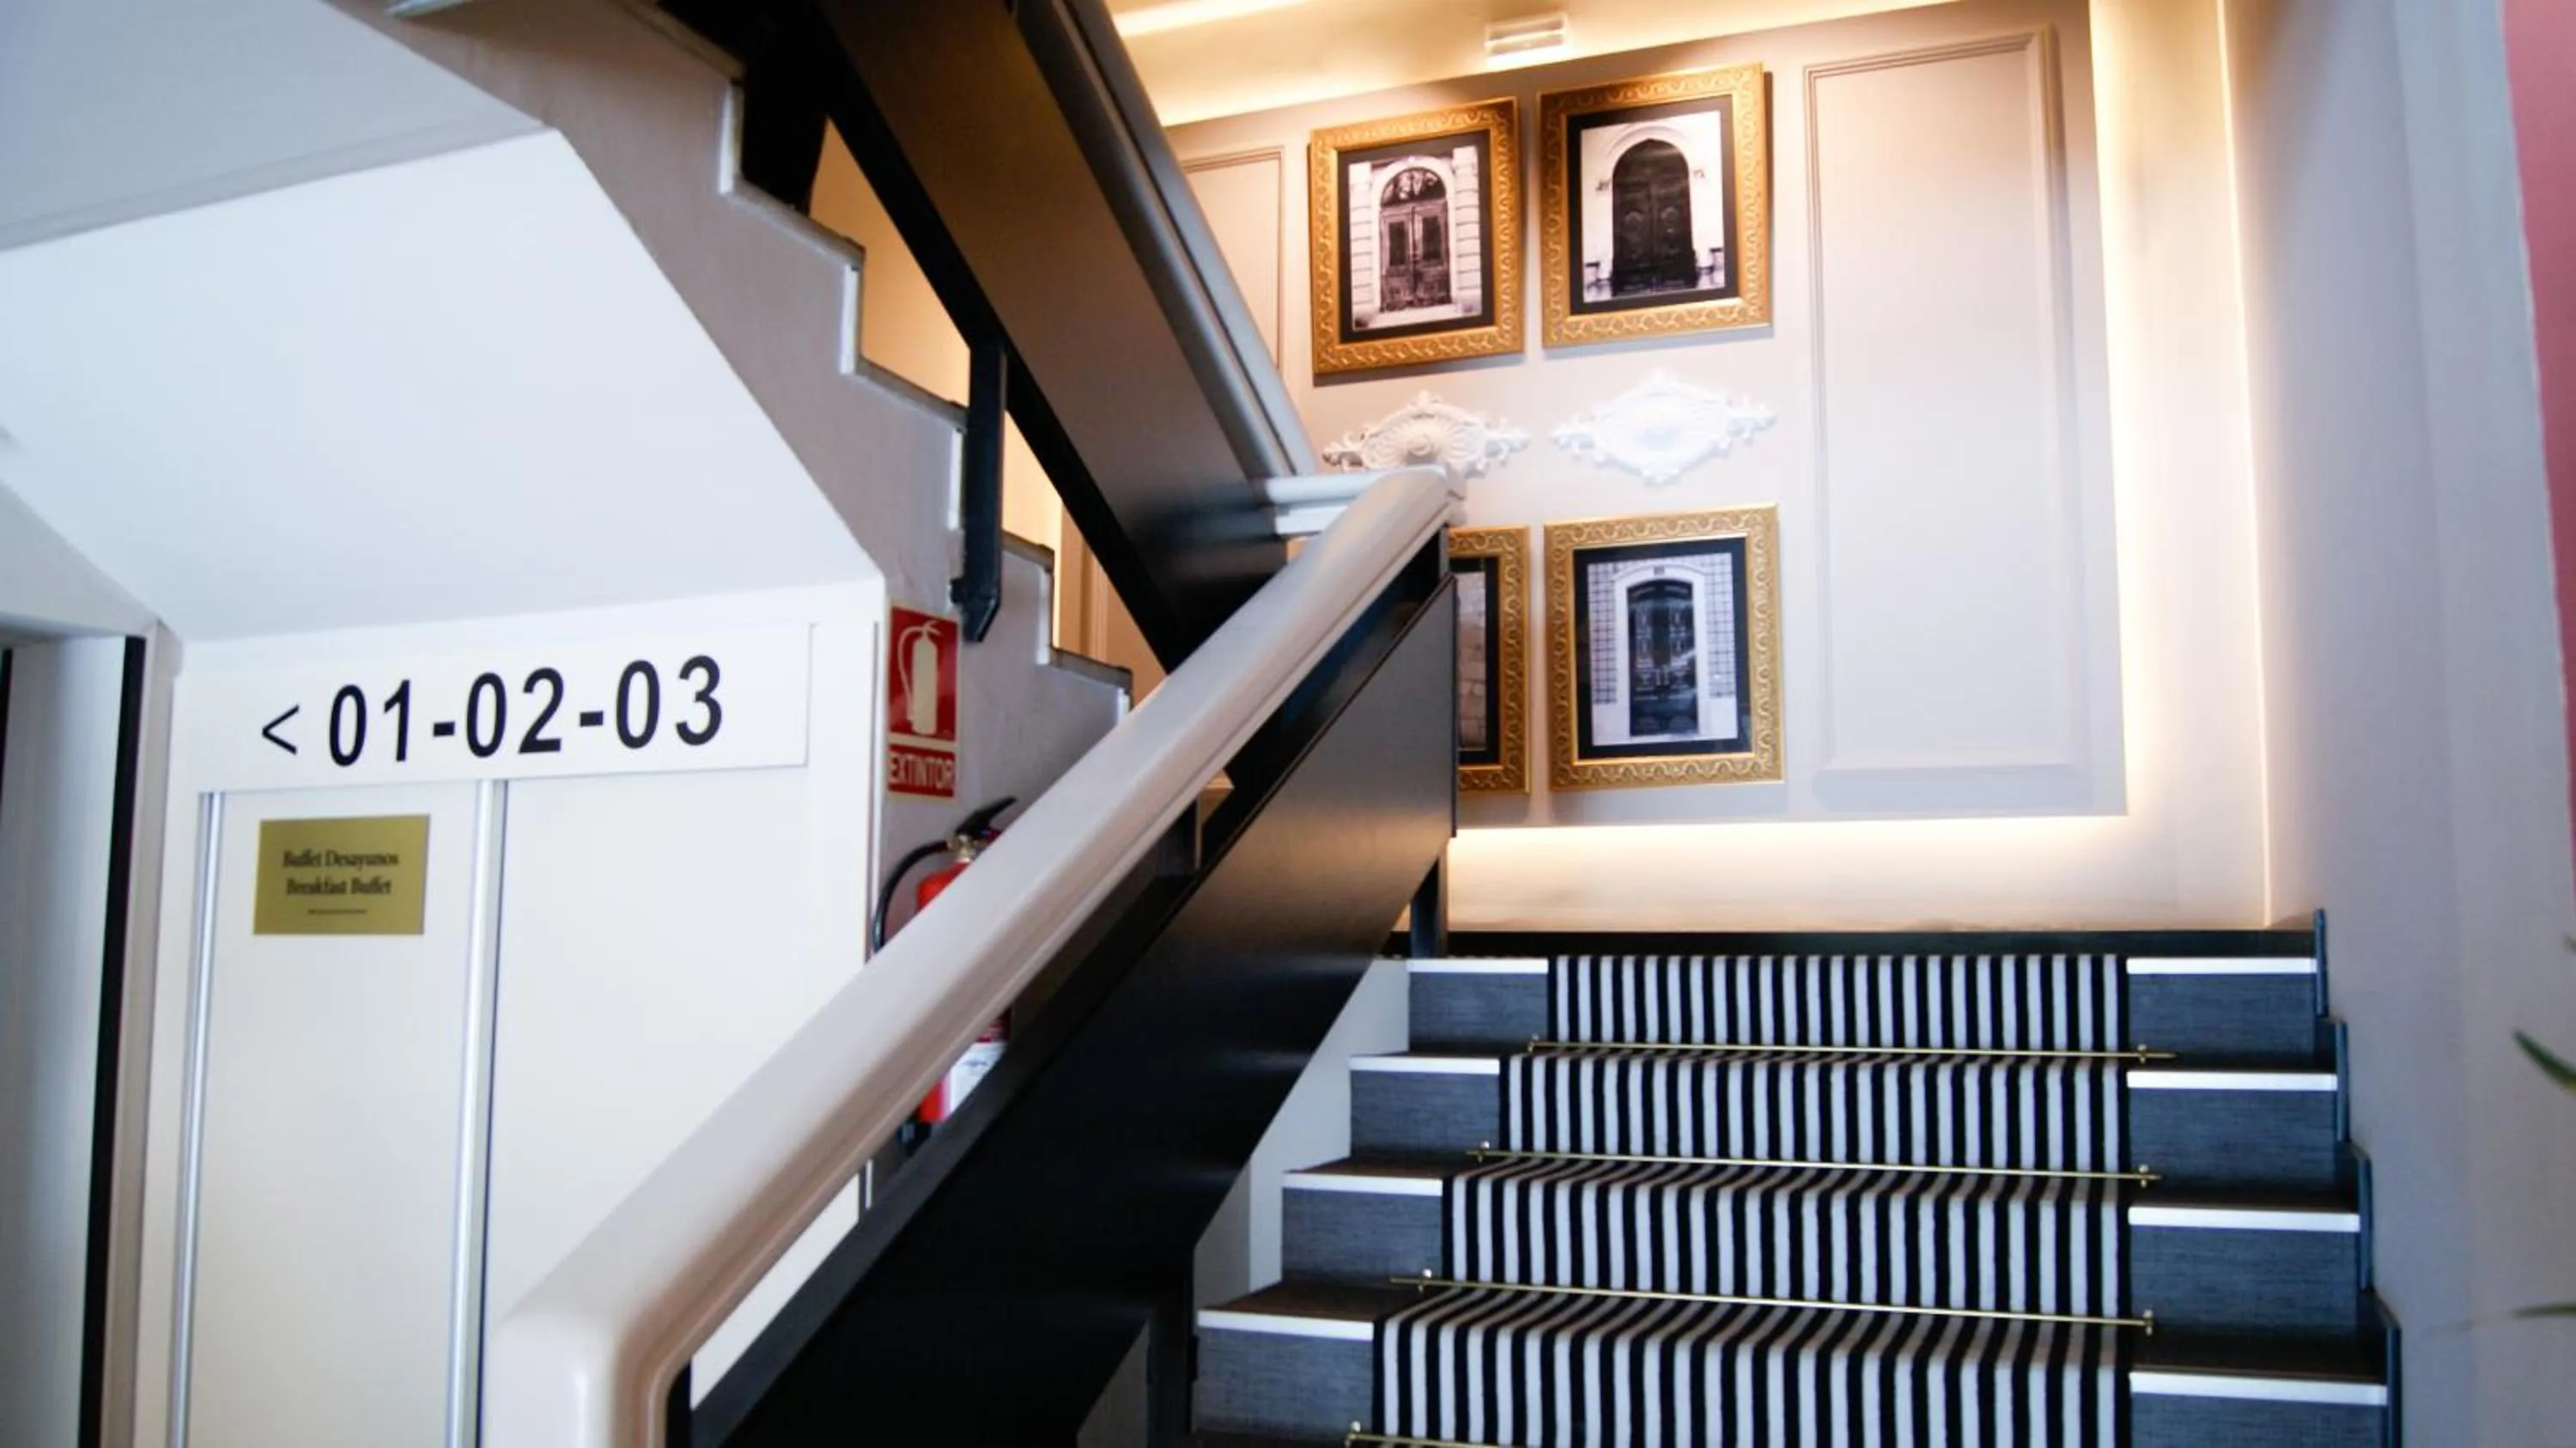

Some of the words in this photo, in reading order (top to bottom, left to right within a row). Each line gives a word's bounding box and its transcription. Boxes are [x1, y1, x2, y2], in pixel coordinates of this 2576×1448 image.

[328, 654, 723, 767] 01-02-03
[888, 752, 955, 789] EXTINTOR
[283, 848, 322, 867] Buffet
[325, 849, 399, 872] Desayunos
[286, 876, 347, 895] Breakfast
[350, 875, 392, 895] Buffet
